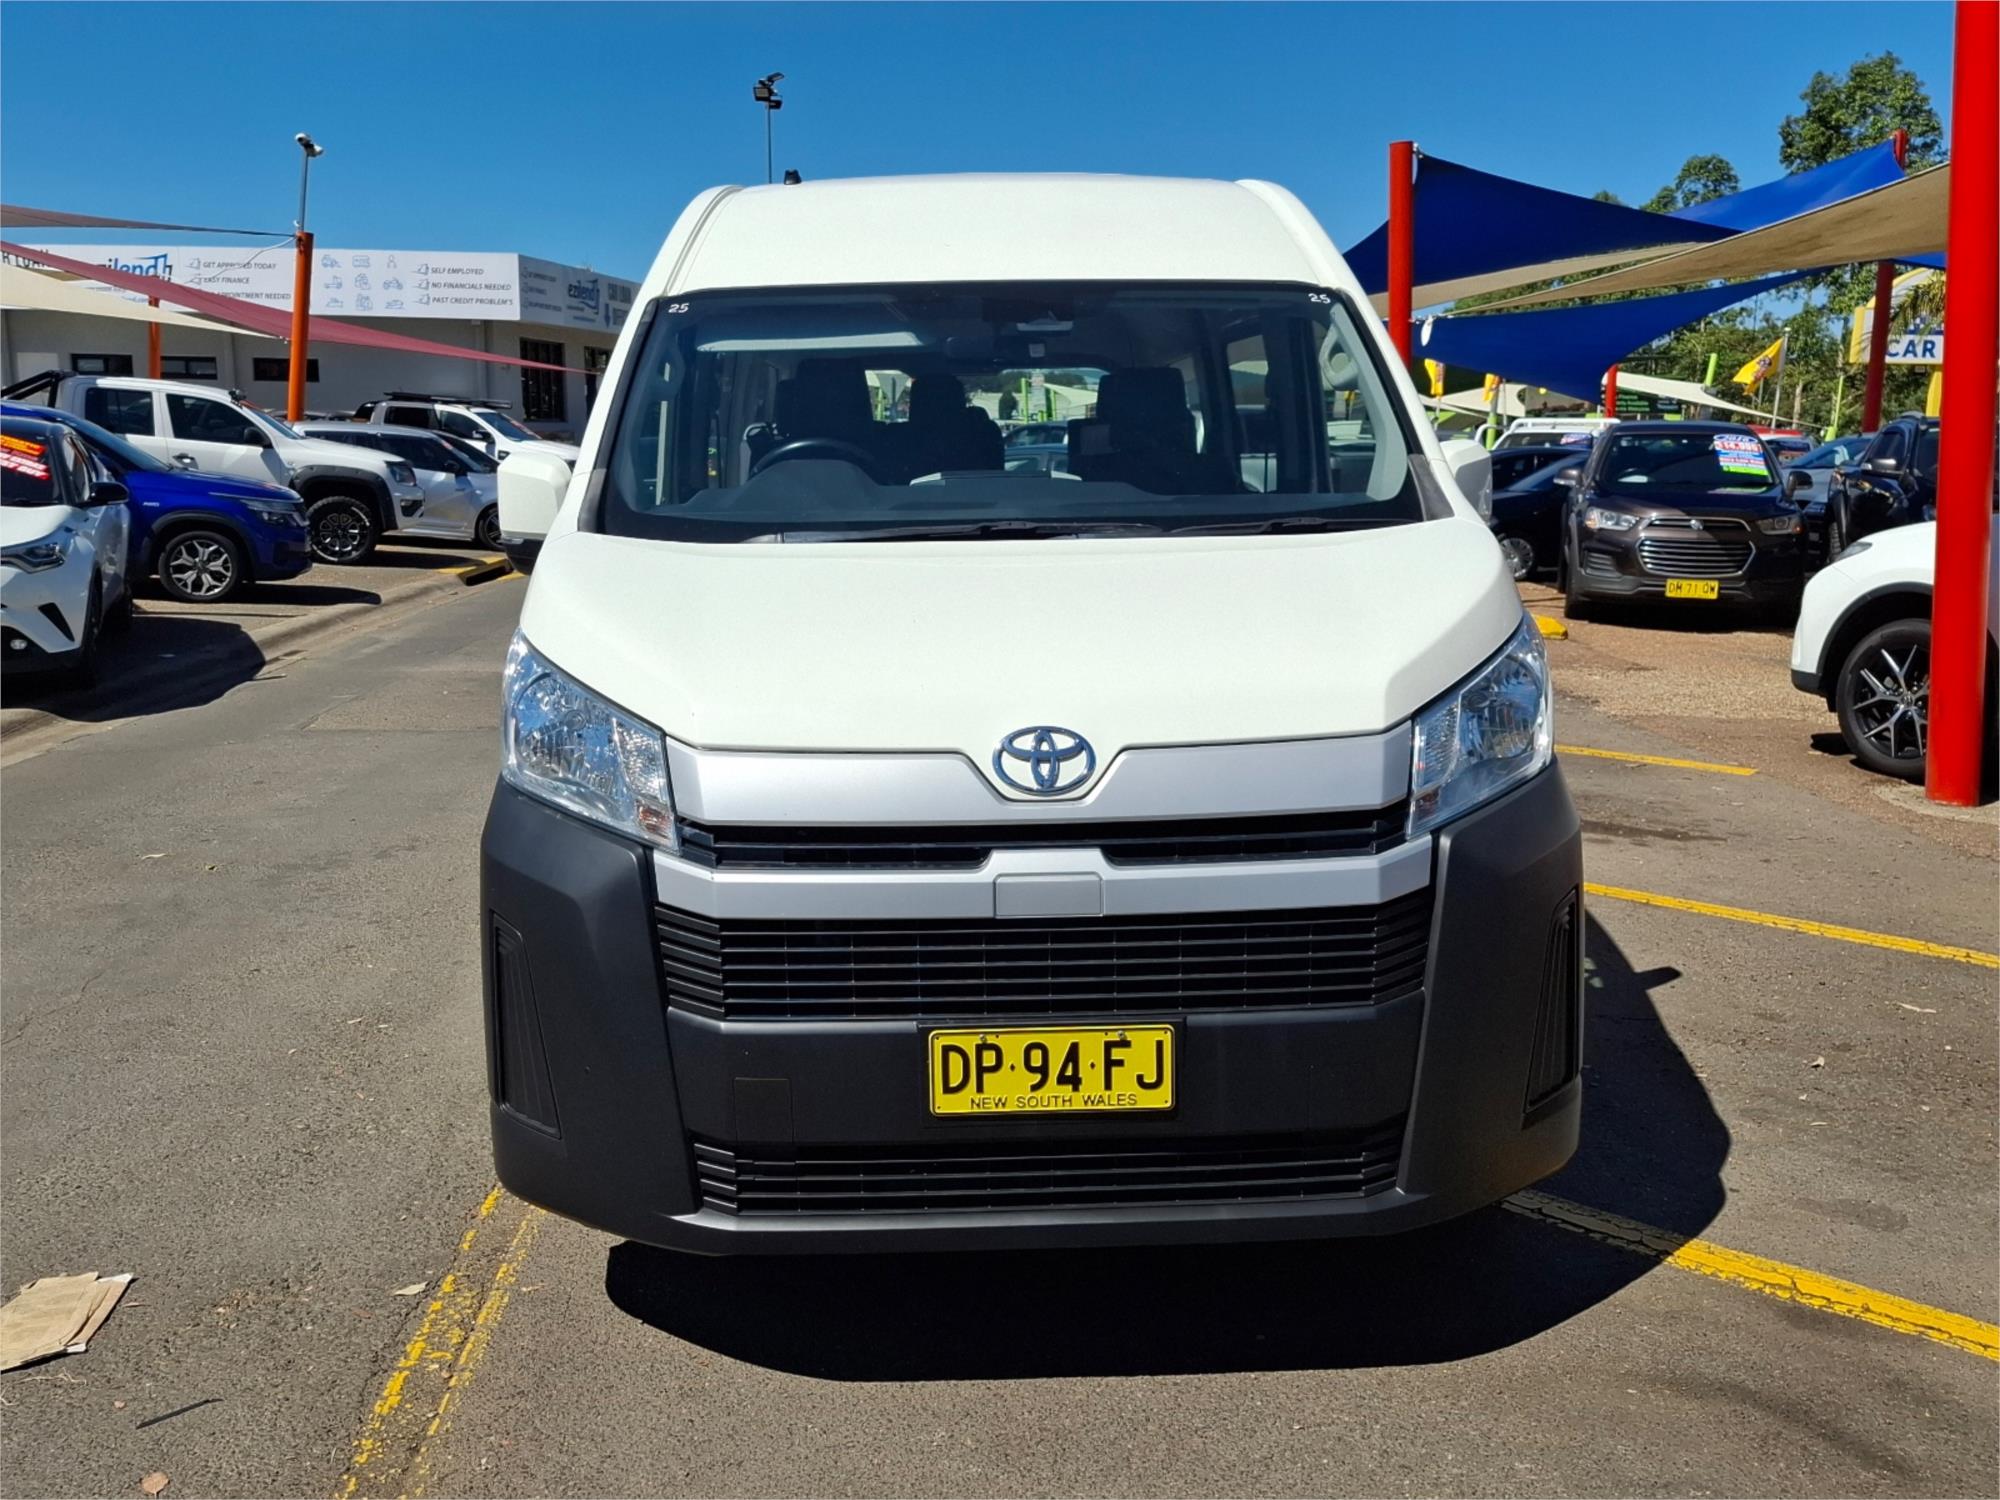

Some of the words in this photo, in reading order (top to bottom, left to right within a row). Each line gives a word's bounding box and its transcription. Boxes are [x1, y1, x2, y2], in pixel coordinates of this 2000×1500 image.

[254, 262, 276, 270] TODAY
[447, 267, 484, 275] EMPLOYED
[431, 282, 442, 290] NO
[443, 282, 482, 290] FINANCIALS
[483, 283, 512, 291] NEEDED
[264, 292, 292, 300] NEEDED
[1308, 293, 1331, 304] 25
[449, 297, 475, 305] CREDIT
[668, 302, 690, 313] 25
[1886, 339, 1936, 358] CAR
[970, 1096, 1007, 1109] NEW
[1016, 1095, 1072, 1108] SOUTH
[1082, 1093, 1137, 1107] WALES
